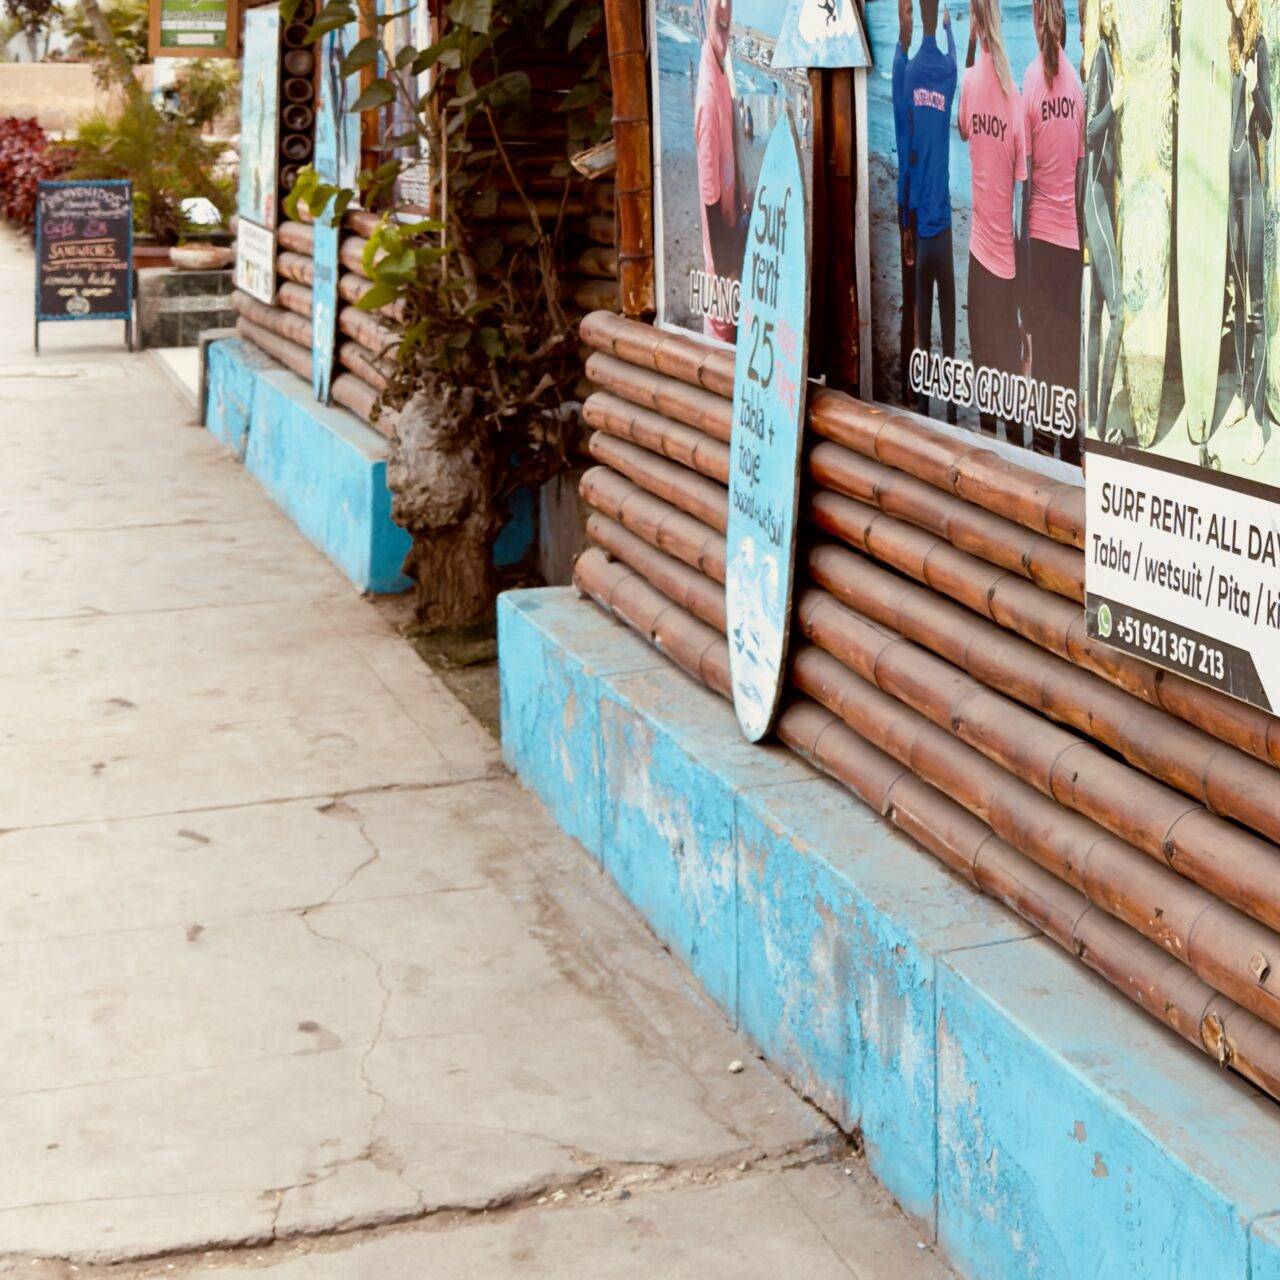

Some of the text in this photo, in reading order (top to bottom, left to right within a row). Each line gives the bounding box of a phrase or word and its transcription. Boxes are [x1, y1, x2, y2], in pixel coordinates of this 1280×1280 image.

[972, 113, 1007, 141] ENJOY
[1041, 96, 1076, 122] ENJOY
[754, 186, 791, 255] Surf
[751, 251, 780, 310] rent
[747, 315, 774, 389] 25
[740, 384, 764, 440] tabla
[910, 348, 1077, 439] CLASES GRUPALES
[1101, 482, 1146, 523] SURF
[1150, 495, 1202, 542] RENT:
[1205, 513, 1242, 556] ALL
[1093, 534, 1131, 575] Tabla
[1133, 542, 1142, 581] /
[1145, 556, 1202, 600] wetsuit
[1205, 566, 1215, 607] /
[1217, 574, 1250, 618] Pita
[1254, 582, 1263, 625] /
[1117, 616, 1224, 680] +51 921 367 213
